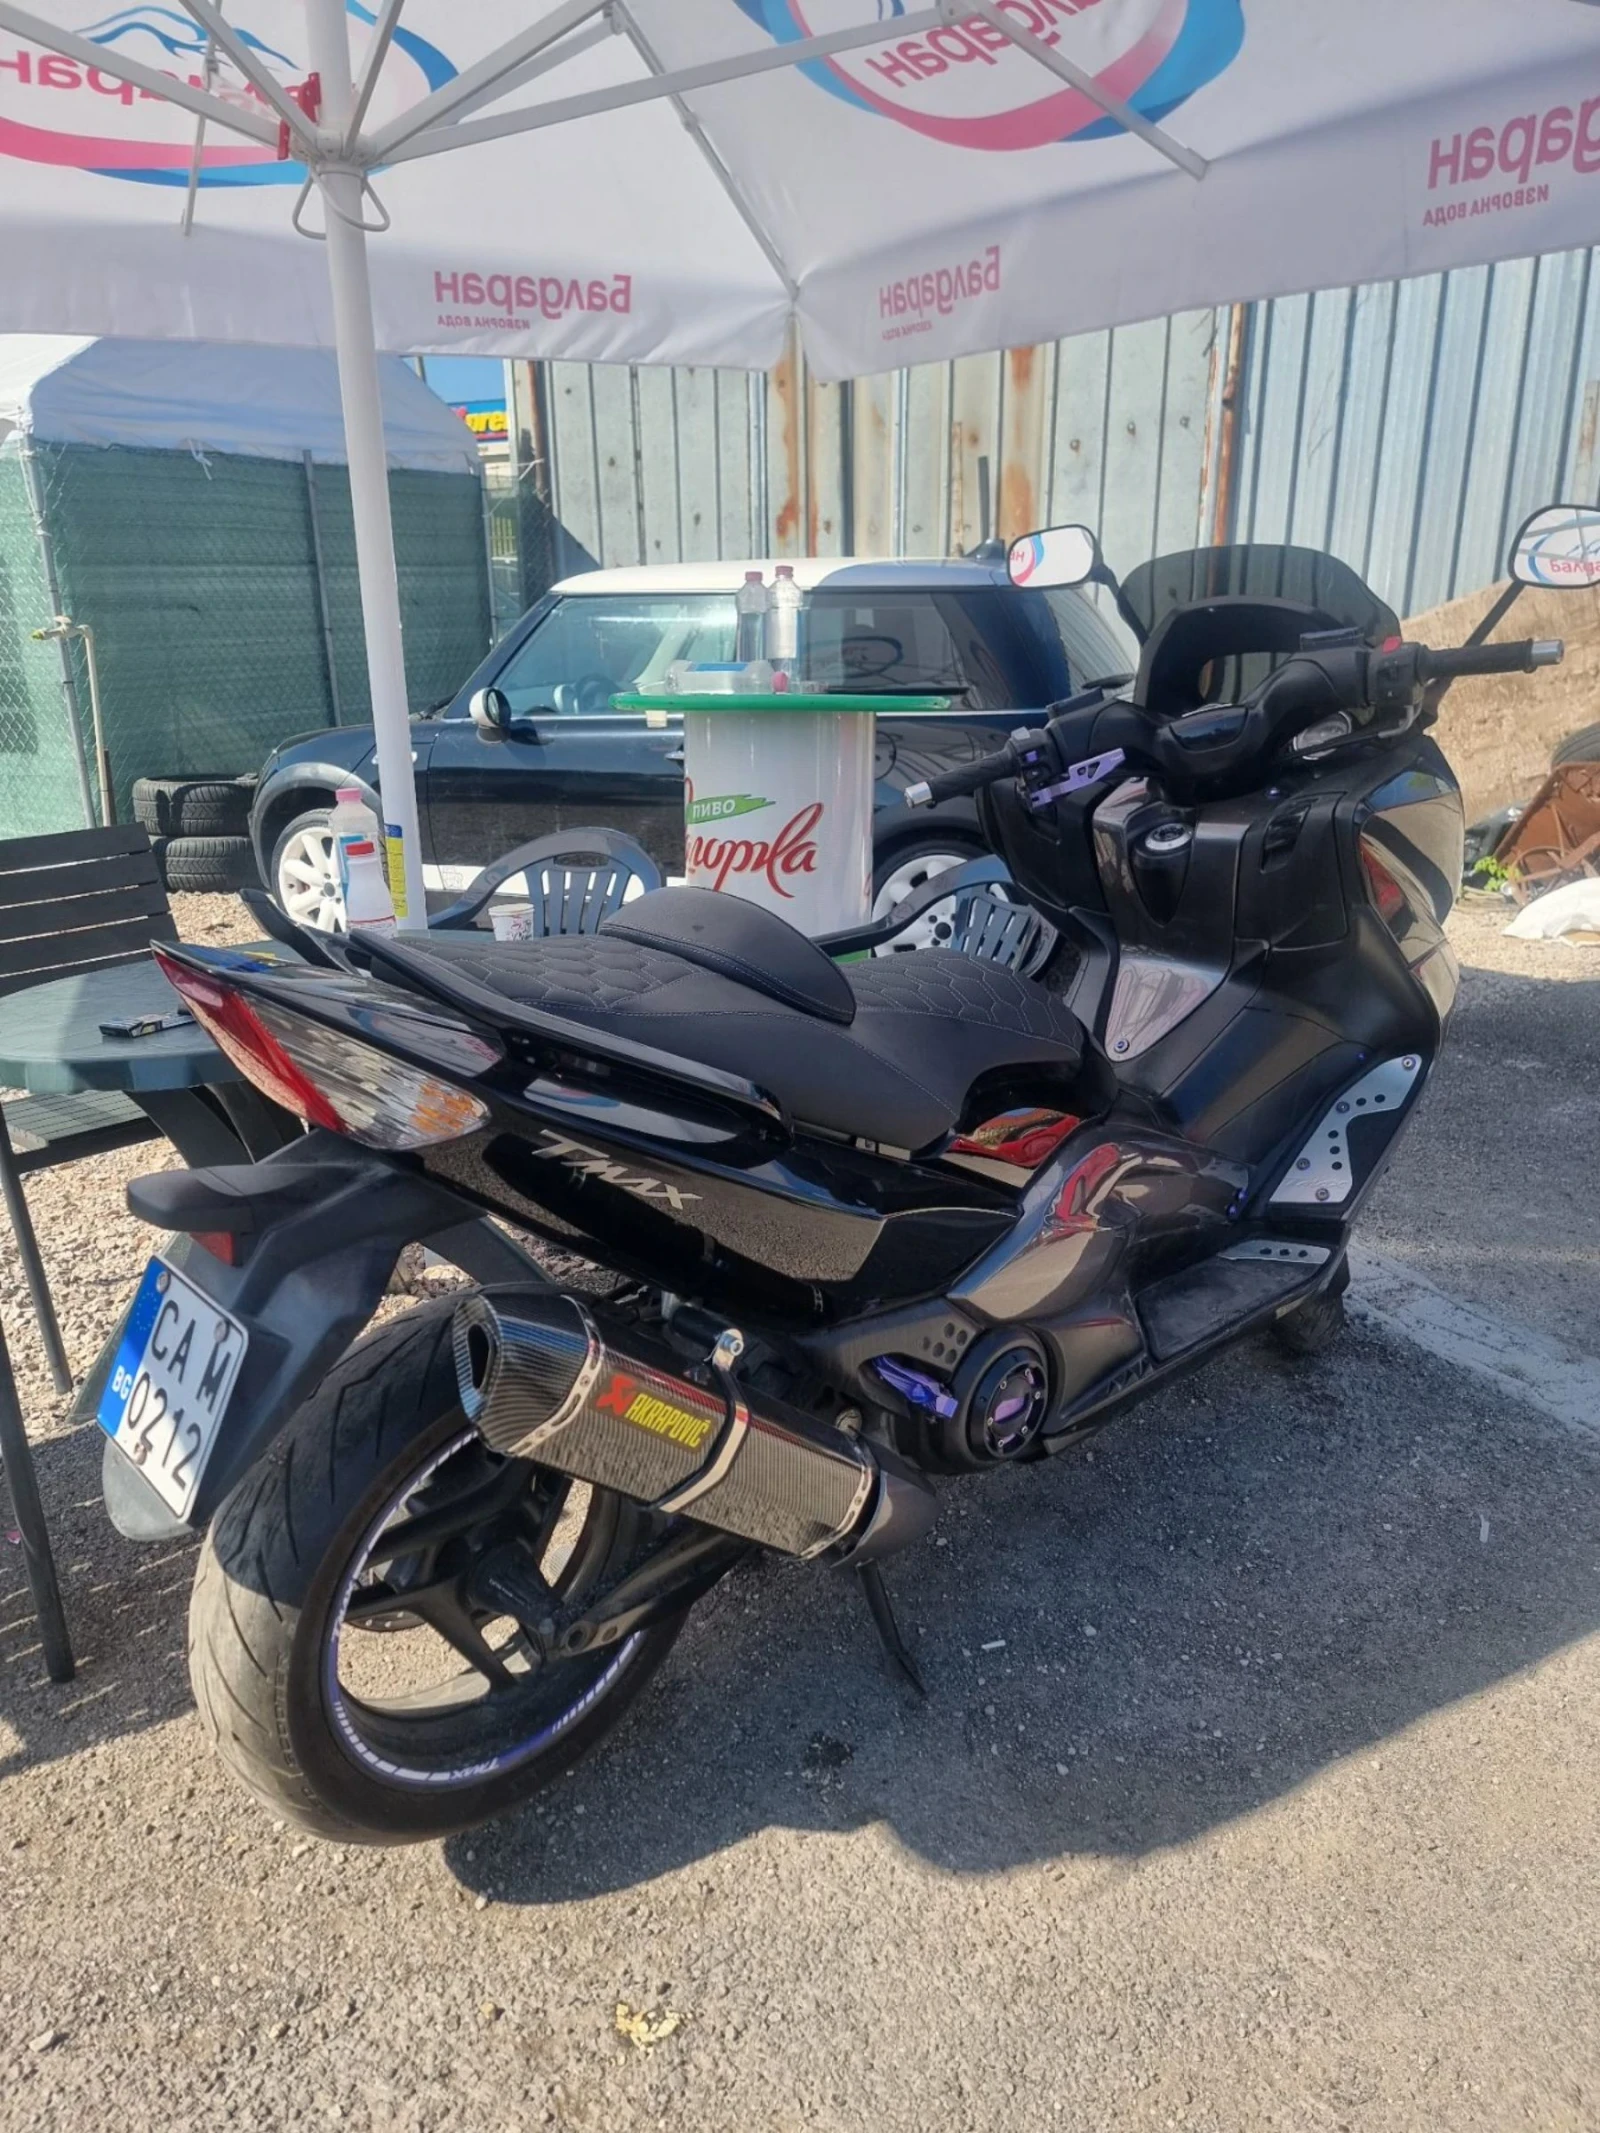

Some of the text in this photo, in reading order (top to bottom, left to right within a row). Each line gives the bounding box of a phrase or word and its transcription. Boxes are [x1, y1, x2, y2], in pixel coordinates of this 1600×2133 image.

[692, 799, 736, 818] ПИВО
[531, 1129, 704, 1210] TMAX
[111, 1364, 133, 1400] BG
[127, 1371, 202, 1491] 0212
